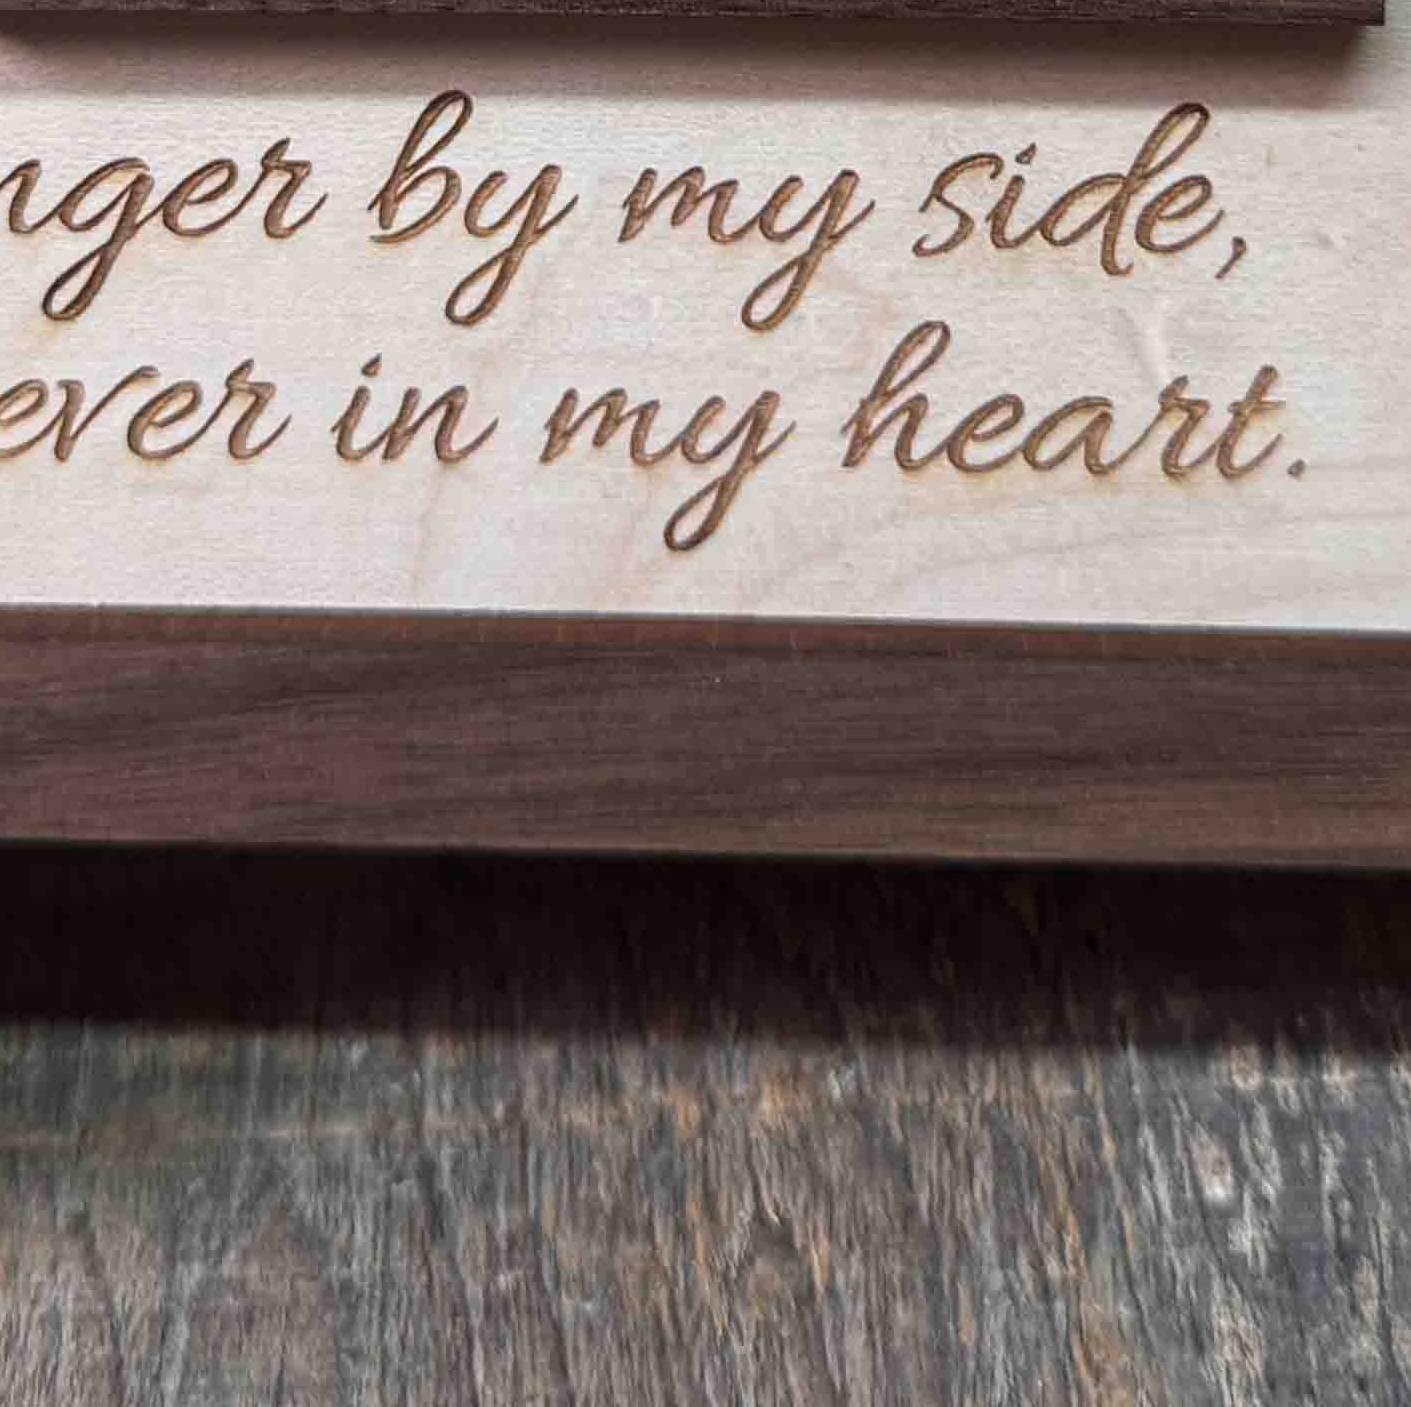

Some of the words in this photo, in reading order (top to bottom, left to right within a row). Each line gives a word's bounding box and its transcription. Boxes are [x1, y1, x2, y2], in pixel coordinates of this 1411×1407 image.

[366, 88, 580, 328] by
[617, 164, 876, 333] my
[912, 101, 1247, 281] side,
[330, 353, 499, 465] in
[539, 385, 797, 553] my
[840, 319, 1308, 480] heart.
